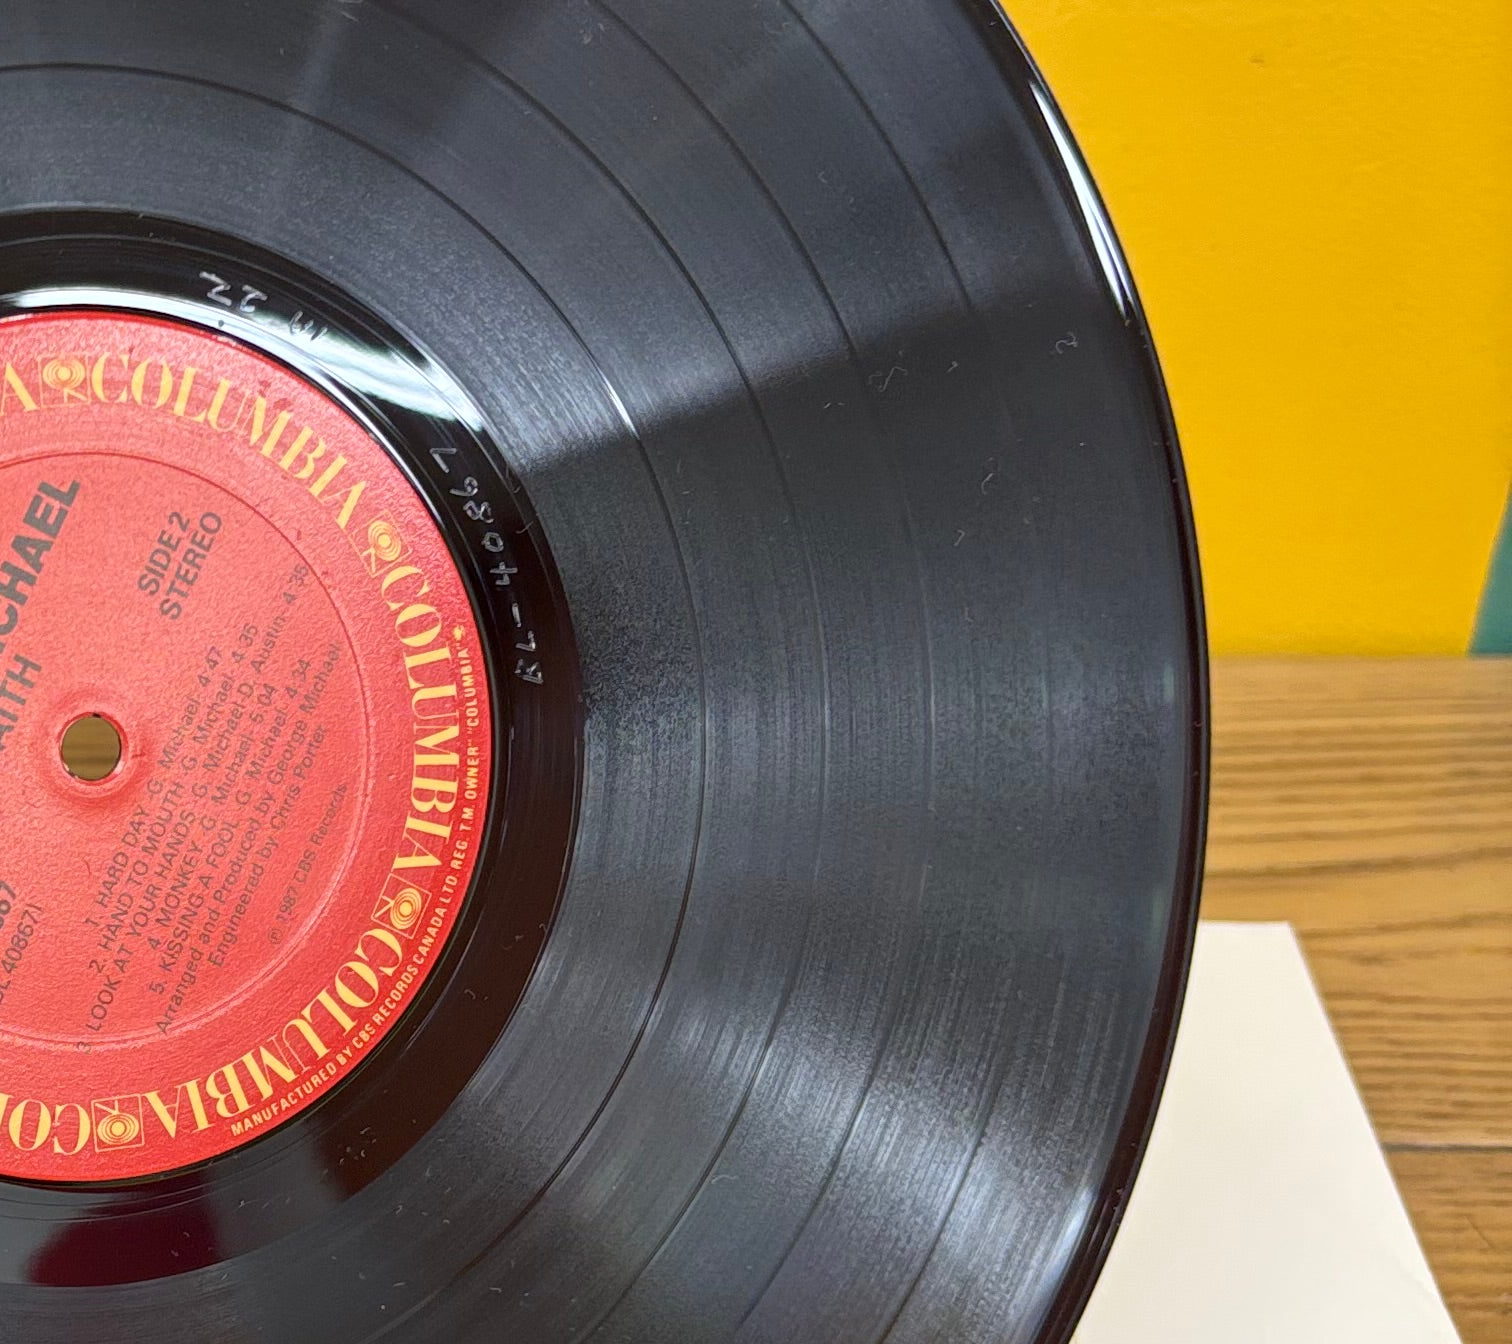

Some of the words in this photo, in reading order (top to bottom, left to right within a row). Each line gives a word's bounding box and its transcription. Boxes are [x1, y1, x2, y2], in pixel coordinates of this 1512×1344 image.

[92, 351, 366, 529] COLUMBIA
[137, 531, 181, 596] SIDE
[166, 510, 190, 532] 2
[159, 510, 223, 620] STEREO
[381, 565, 460, 873] COLUMBIA
[94, 851, 129, 908] HARD
[121, 805, 150, 847] DAY
[98, 892, 134, 951] HAND
[126, 859, 149, 886] TO
[141, 781, 185, 856] MOUTH
[154, 947, 206, 1035] Arranged
[196, 907, 221, 944] and
[212, 817, 262, 905] Produced
[253, 790, 277, 816] by
[266, 719, 309, 786] George
[298, 643, 341, 714] Michael
[155, 841, 203, 927] MONKEY
[197, 872, 214, 888] A
[205, 819, 239, 869] FOOL
[207, 863, 267, 968] Engineered
[256, 835, 280, 860] by
[269, 783, 301, 831] Chris
[292, 724, 328, 780] Porter
[0, 903, 43, 975] 40867)
[85, 975, 121, 1031] LOOK
[112, 943, 134, 973] AT
[126, 883, 162, 938] YOUR
[154, 809, 196, 879] HANDS
[158, 892, 205, 972] KISSING
[146, 928, 404, 1139] COLUMBIA
[231, 1061, 337, 1137] MANUFACTURED
[336, 1045, 354, 1066] BY
[352, 1023, 376, 1048] CBS
[372, 965, 419, 1026] RECORDS
[413, 906, 448, 965] CANADA
